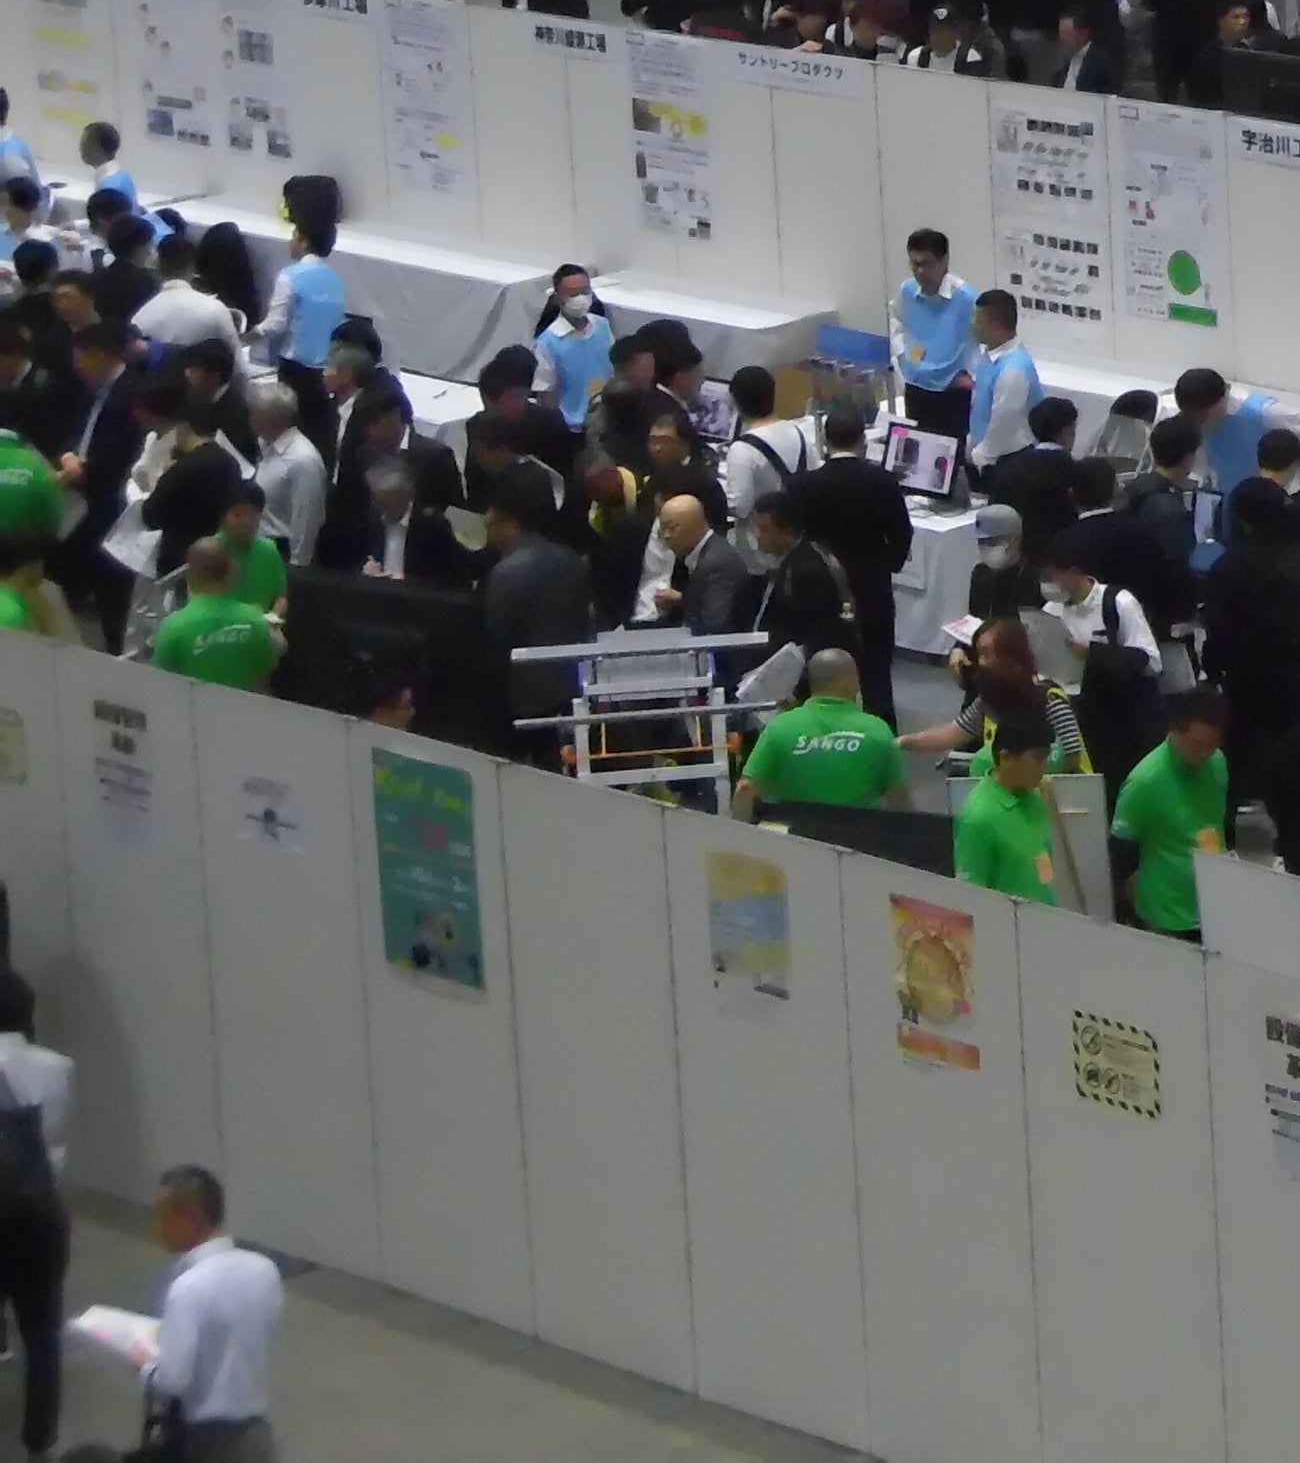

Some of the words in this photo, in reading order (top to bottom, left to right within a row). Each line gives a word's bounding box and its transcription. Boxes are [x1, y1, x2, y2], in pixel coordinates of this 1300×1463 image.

[738, 51, 844, 81] サントリープロダクツ
[793, 731, 865, 755] SANGO
